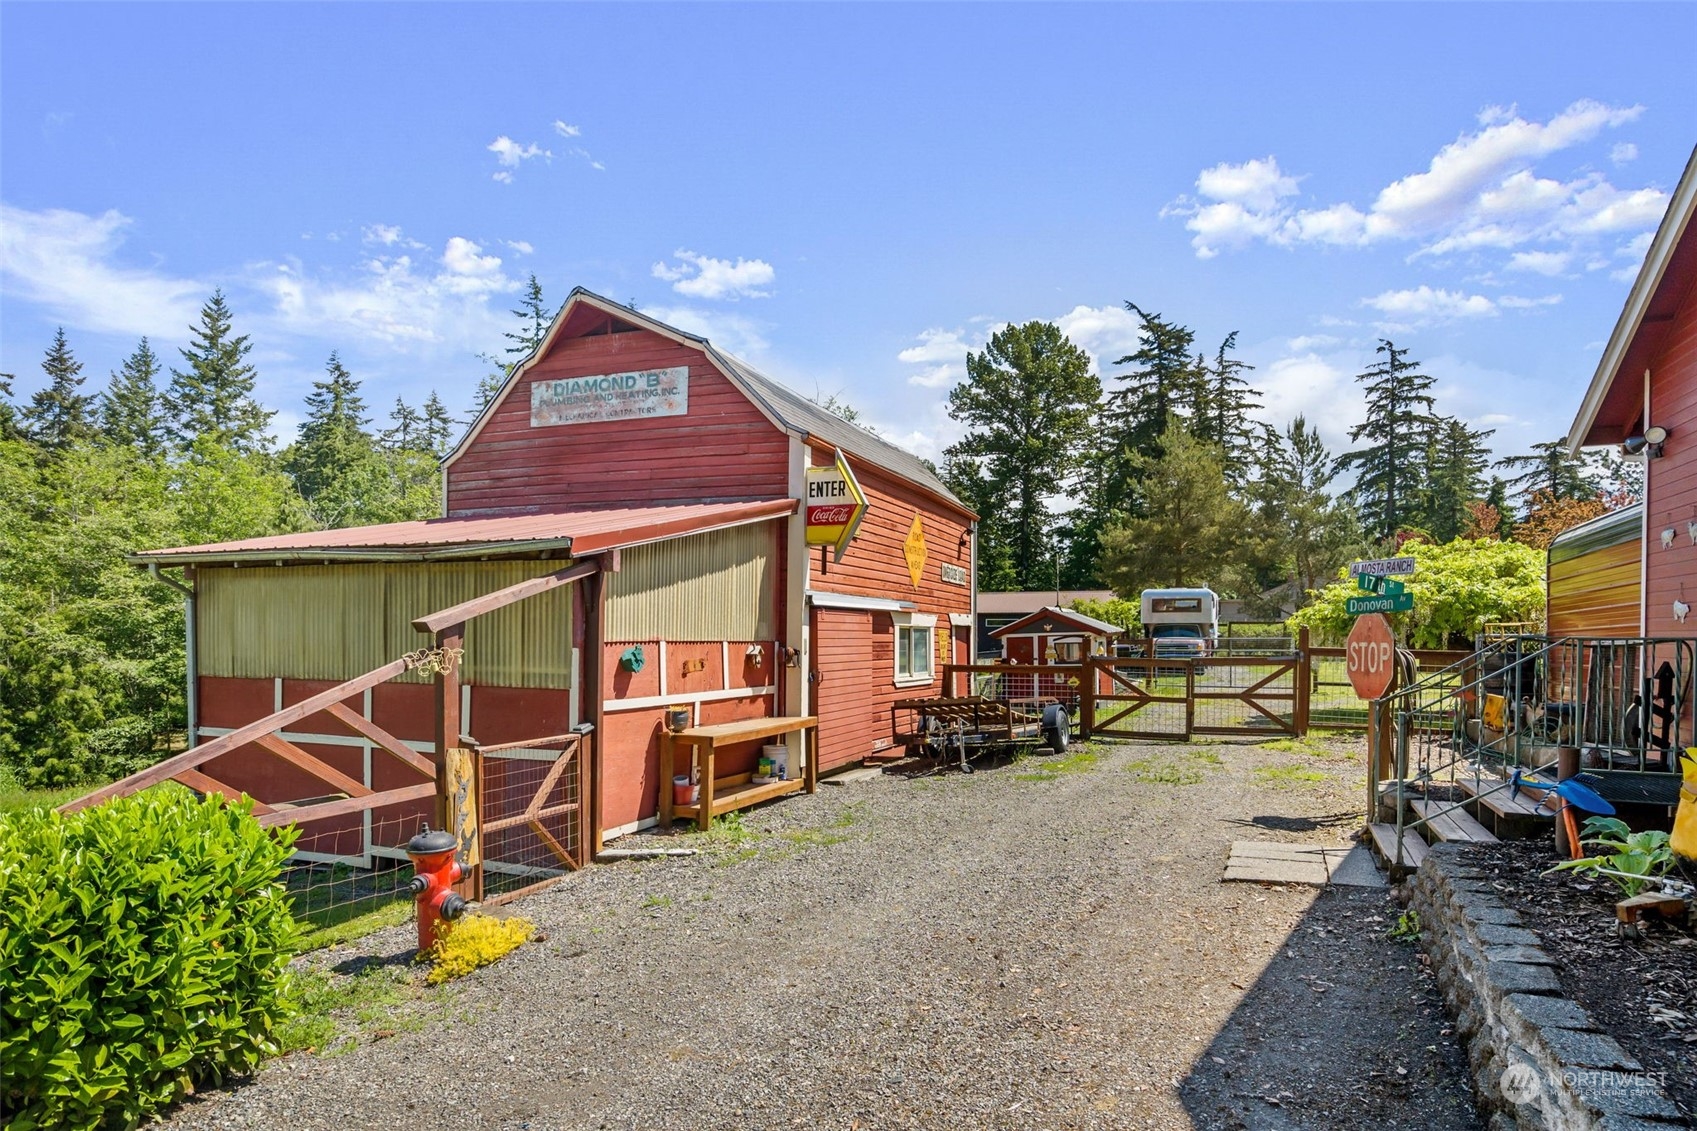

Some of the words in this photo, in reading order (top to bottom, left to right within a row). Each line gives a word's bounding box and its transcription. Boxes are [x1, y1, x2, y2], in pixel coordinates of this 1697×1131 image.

[553, 374, 637, 397] DIAMOND
[595, 392, 613, 402] AND
[809, 480, 846, 498] ENTER
[811, 507, 849, 523] Coca-Cola
[1386, 560, 1413, 573] RANCH
[1350, 598, 1394, 612] Donovan
[1349, 641, 1391, 673] STOP
